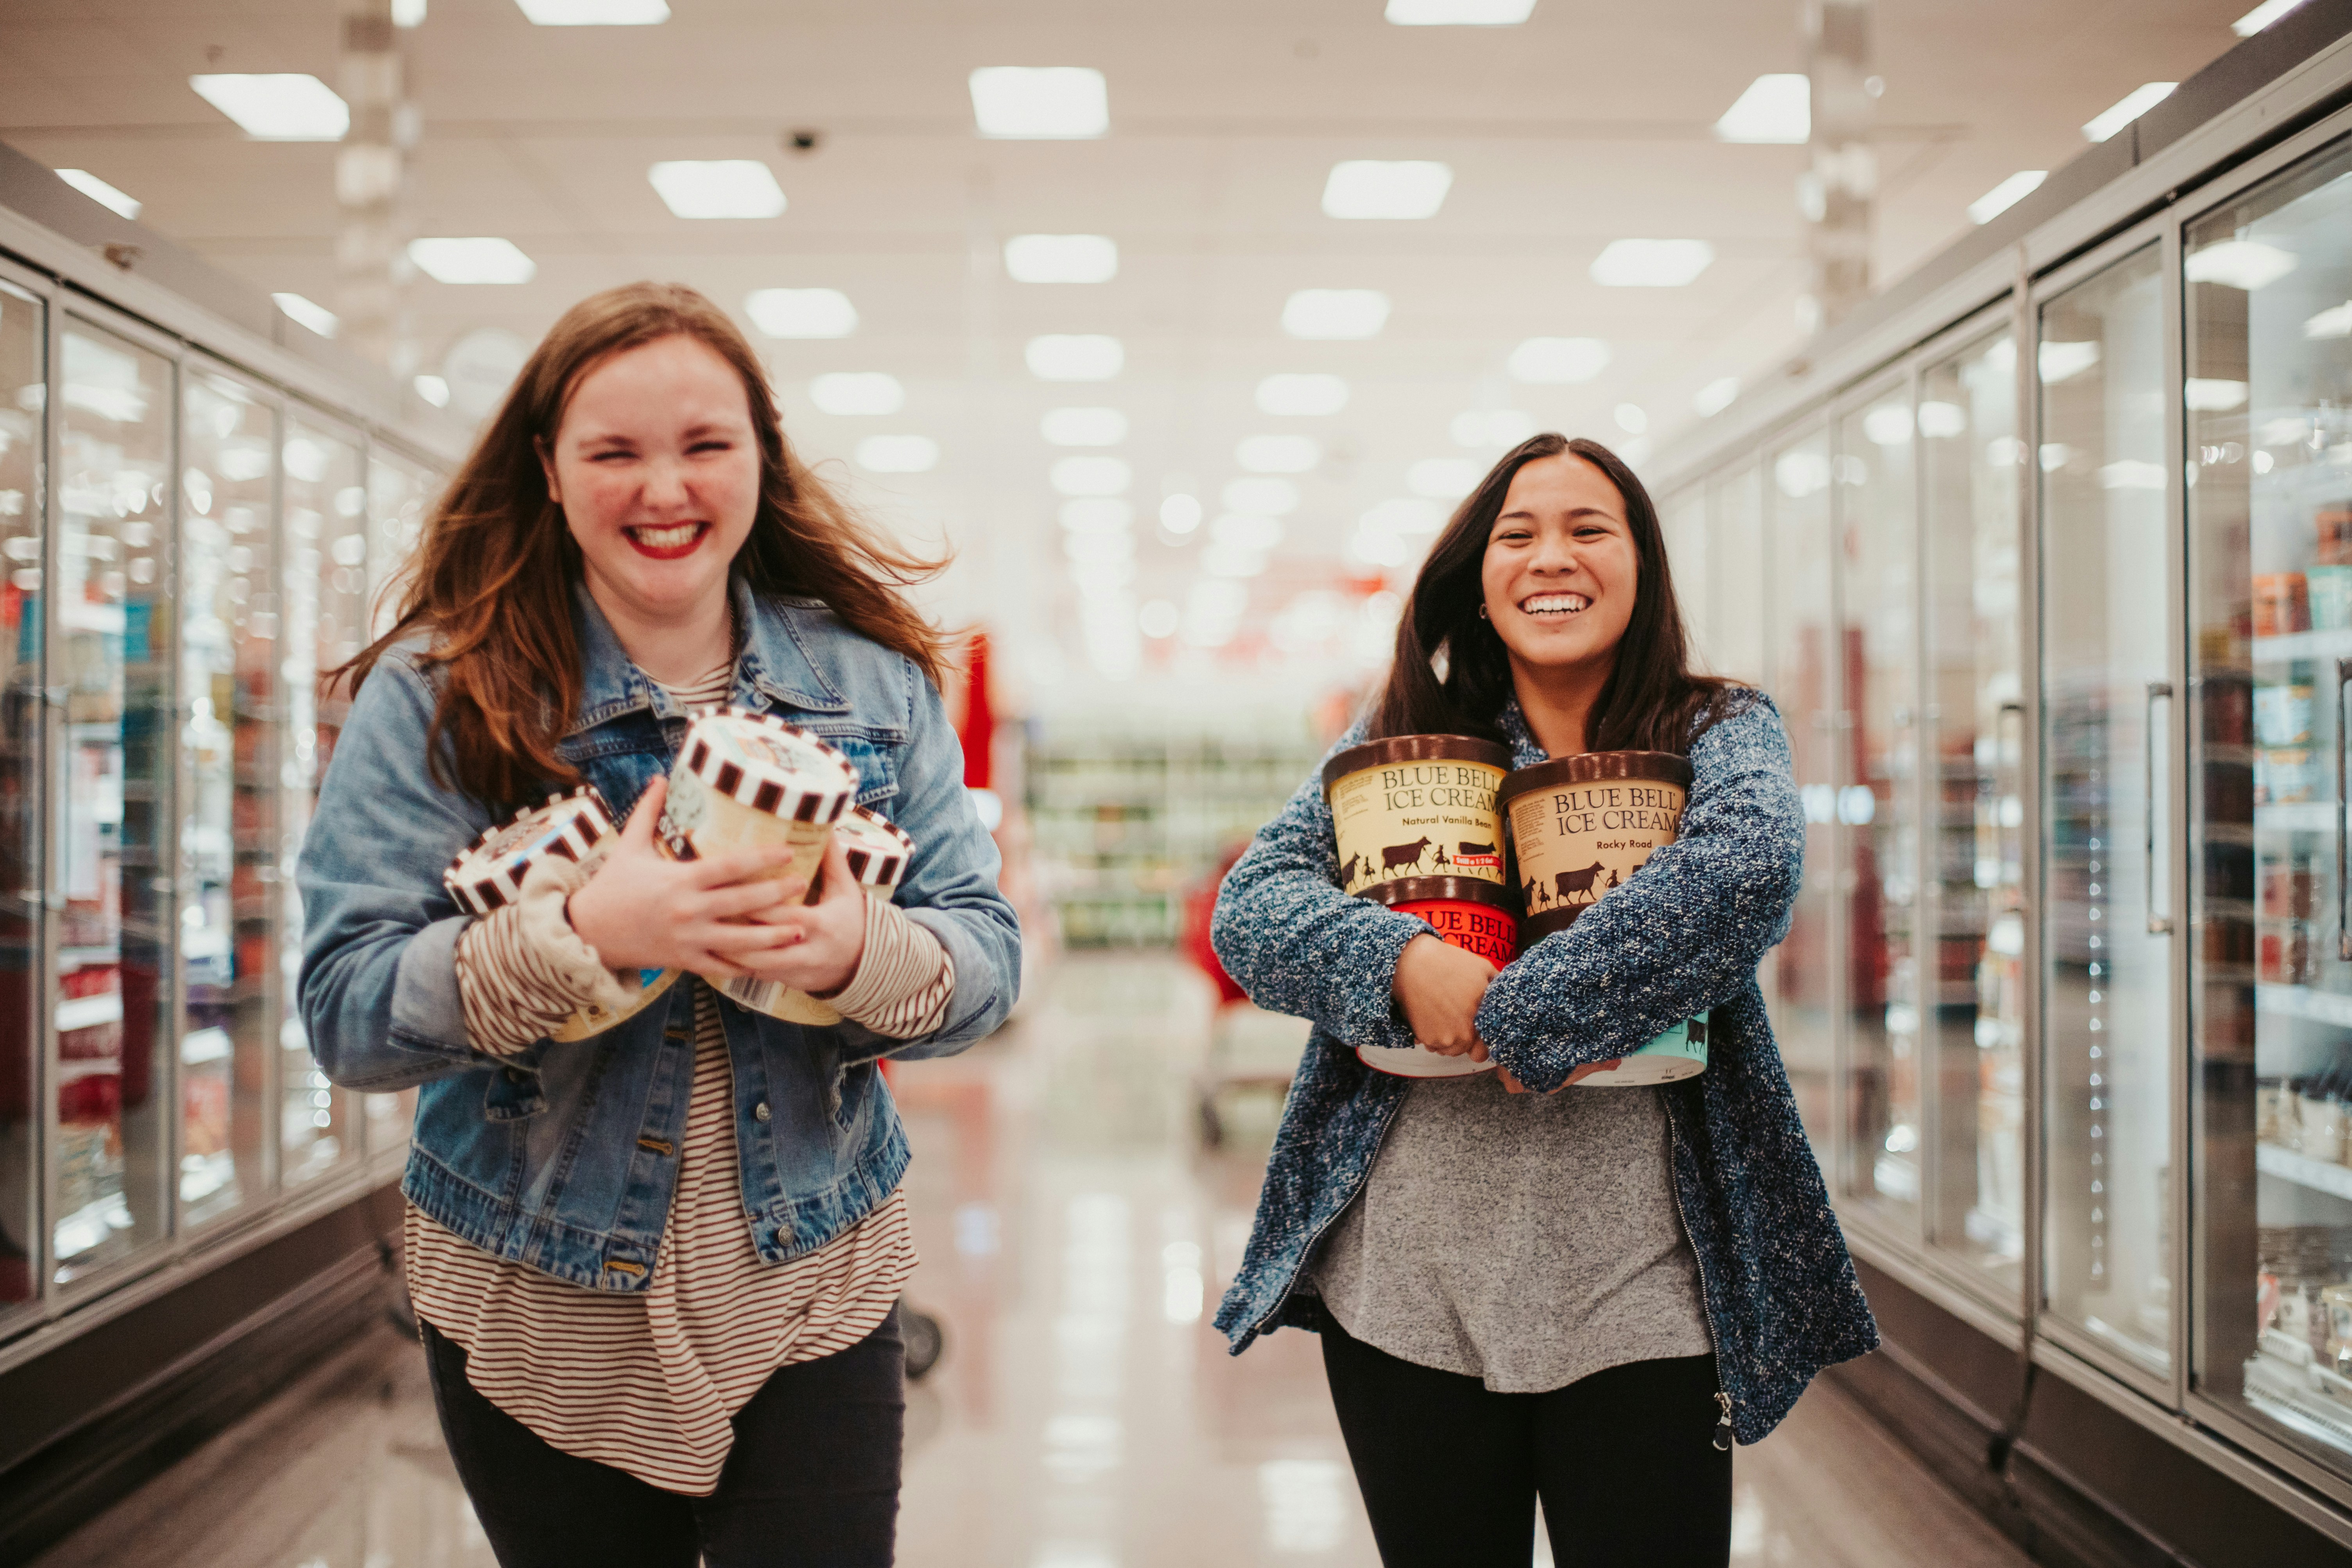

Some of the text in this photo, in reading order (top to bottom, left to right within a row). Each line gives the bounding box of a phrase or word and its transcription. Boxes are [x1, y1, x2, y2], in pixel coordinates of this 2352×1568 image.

[1381, 766, 1449, 790] BLUE
[1455, 767, 1499, 793] BELL
[1383, 788, 1424, 811] ICE
[1430, 788, 1499, 814] CREAM
[1552, 788, 1677, 814] BLUE BELL
[1402, 815, 1492, 829] Natural Vanilla Bean
[1556, 812, 1597, 836] ICE
[1603, 810, 1677, 834] CREAM
[1597, 839, 1652, 850] Rocky Road
[1469, 913, 1514, 945] BELL
